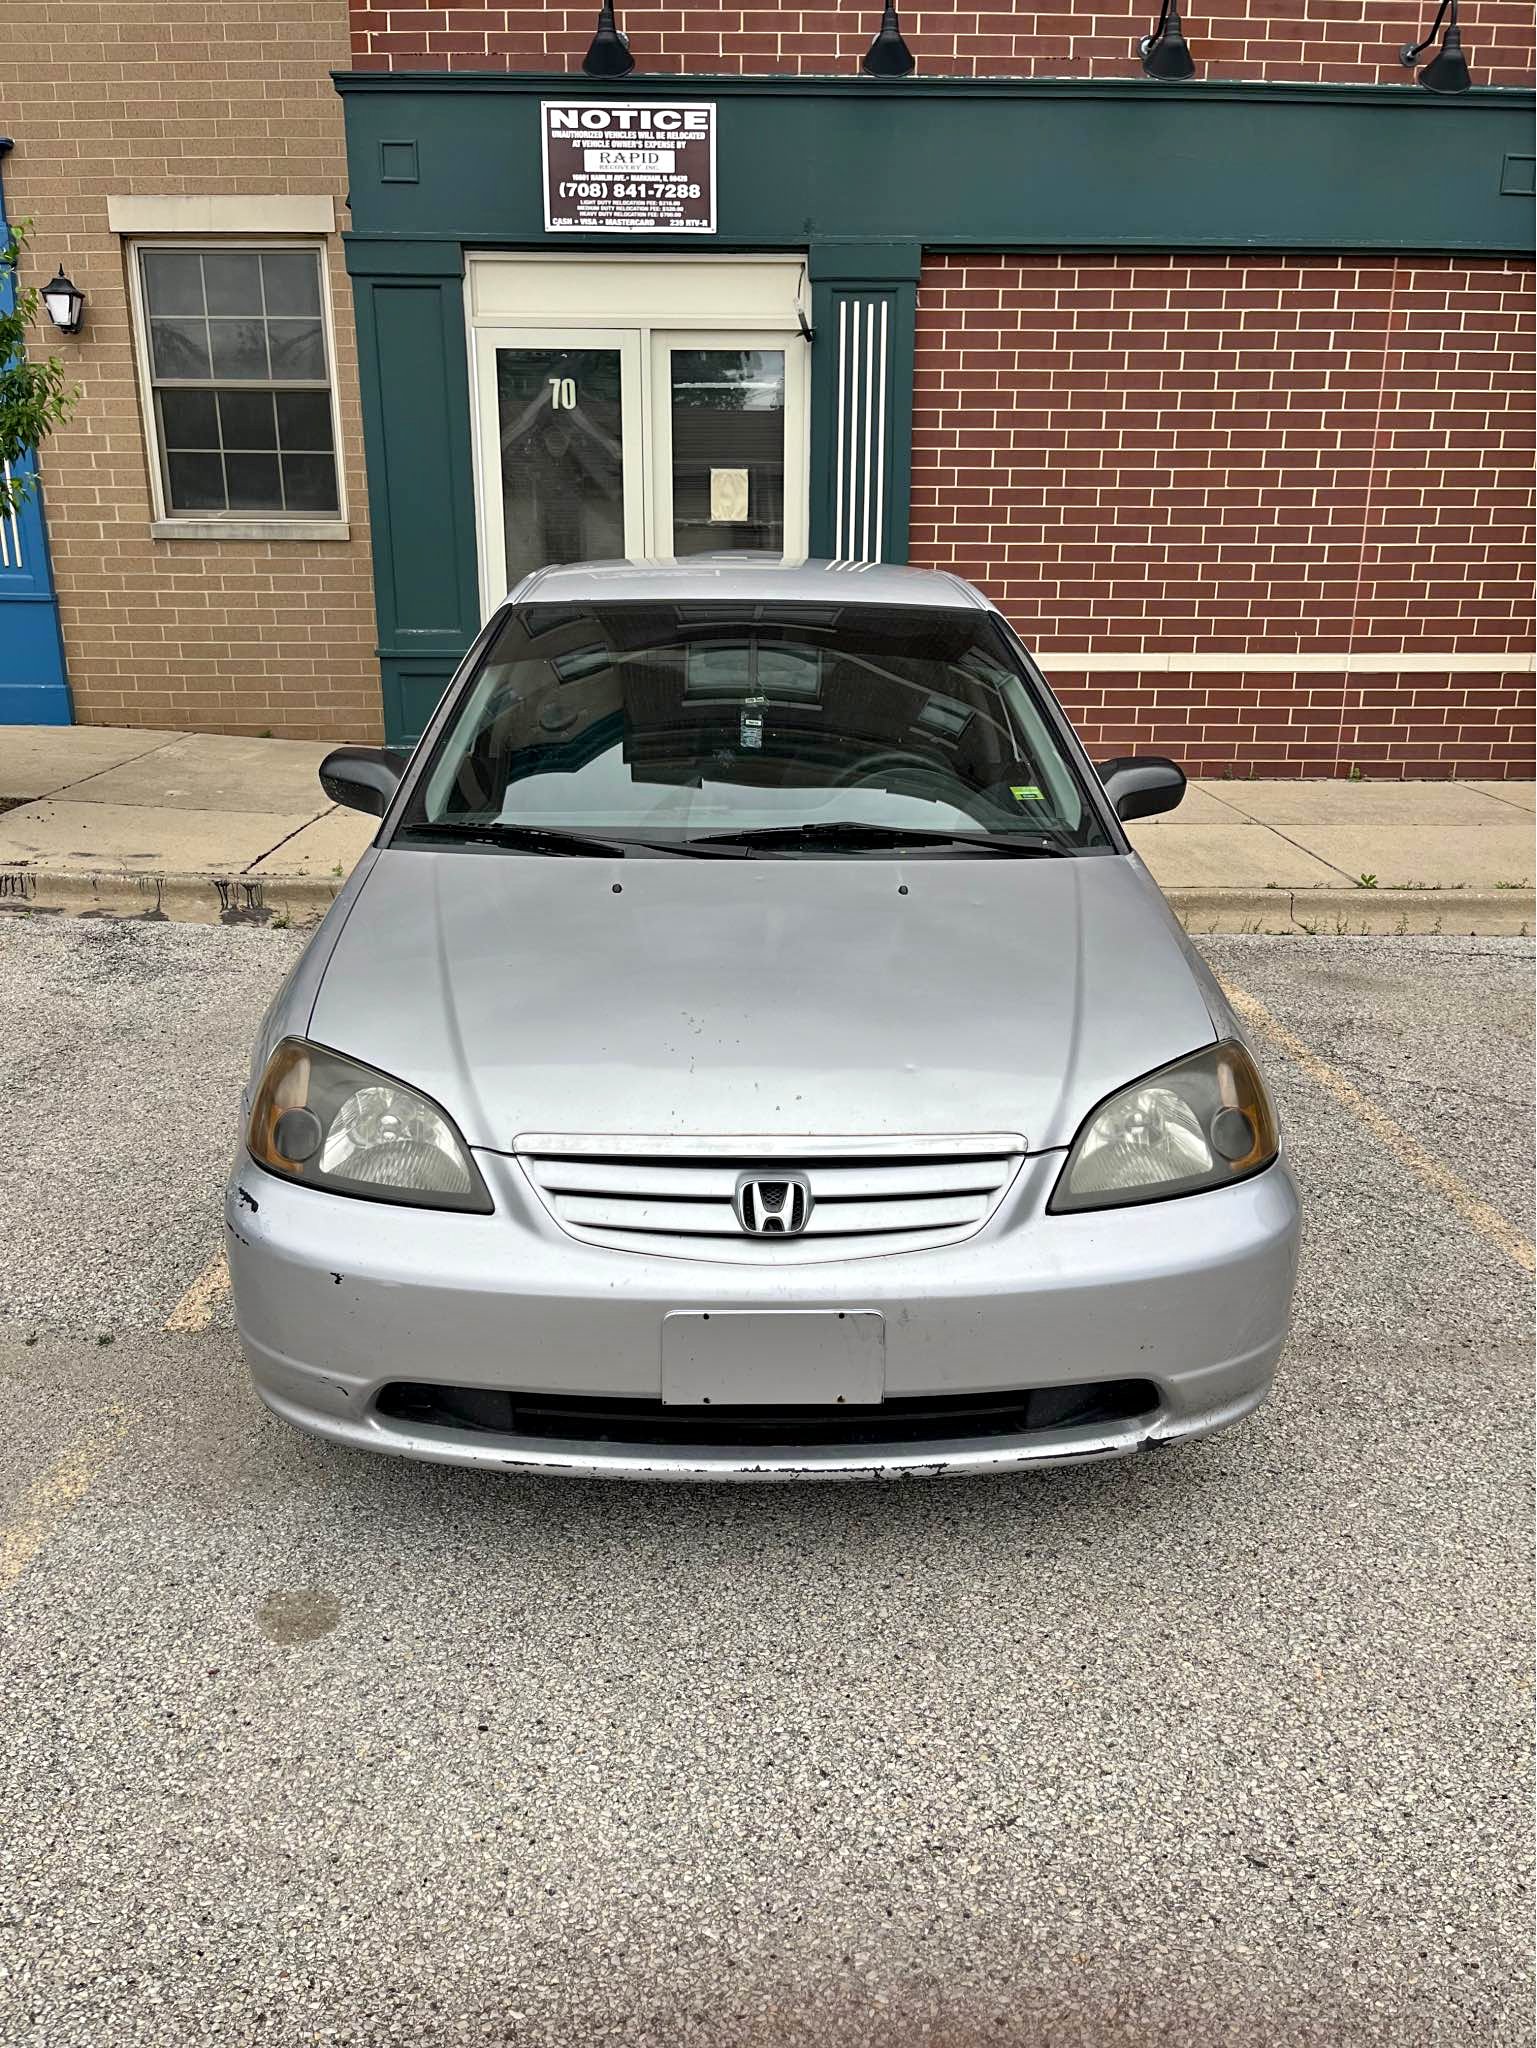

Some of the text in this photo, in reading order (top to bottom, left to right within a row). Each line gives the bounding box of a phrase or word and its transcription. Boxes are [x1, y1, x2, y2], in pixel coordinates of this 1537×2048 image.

[550, 109, 709, 130] NOTICE
[551, 130, 706, 140] UNAUTHORIZED VEHICLES WILL BE RELOCATED
[572, 140, 687, 149] AT VEHICLE OWNER'S EXPENSE BY
[599, 152, 660, 164] RAPID
[559, 182, 701, 199] (708) 841-7288
[549, 378, 577, 410] 70
